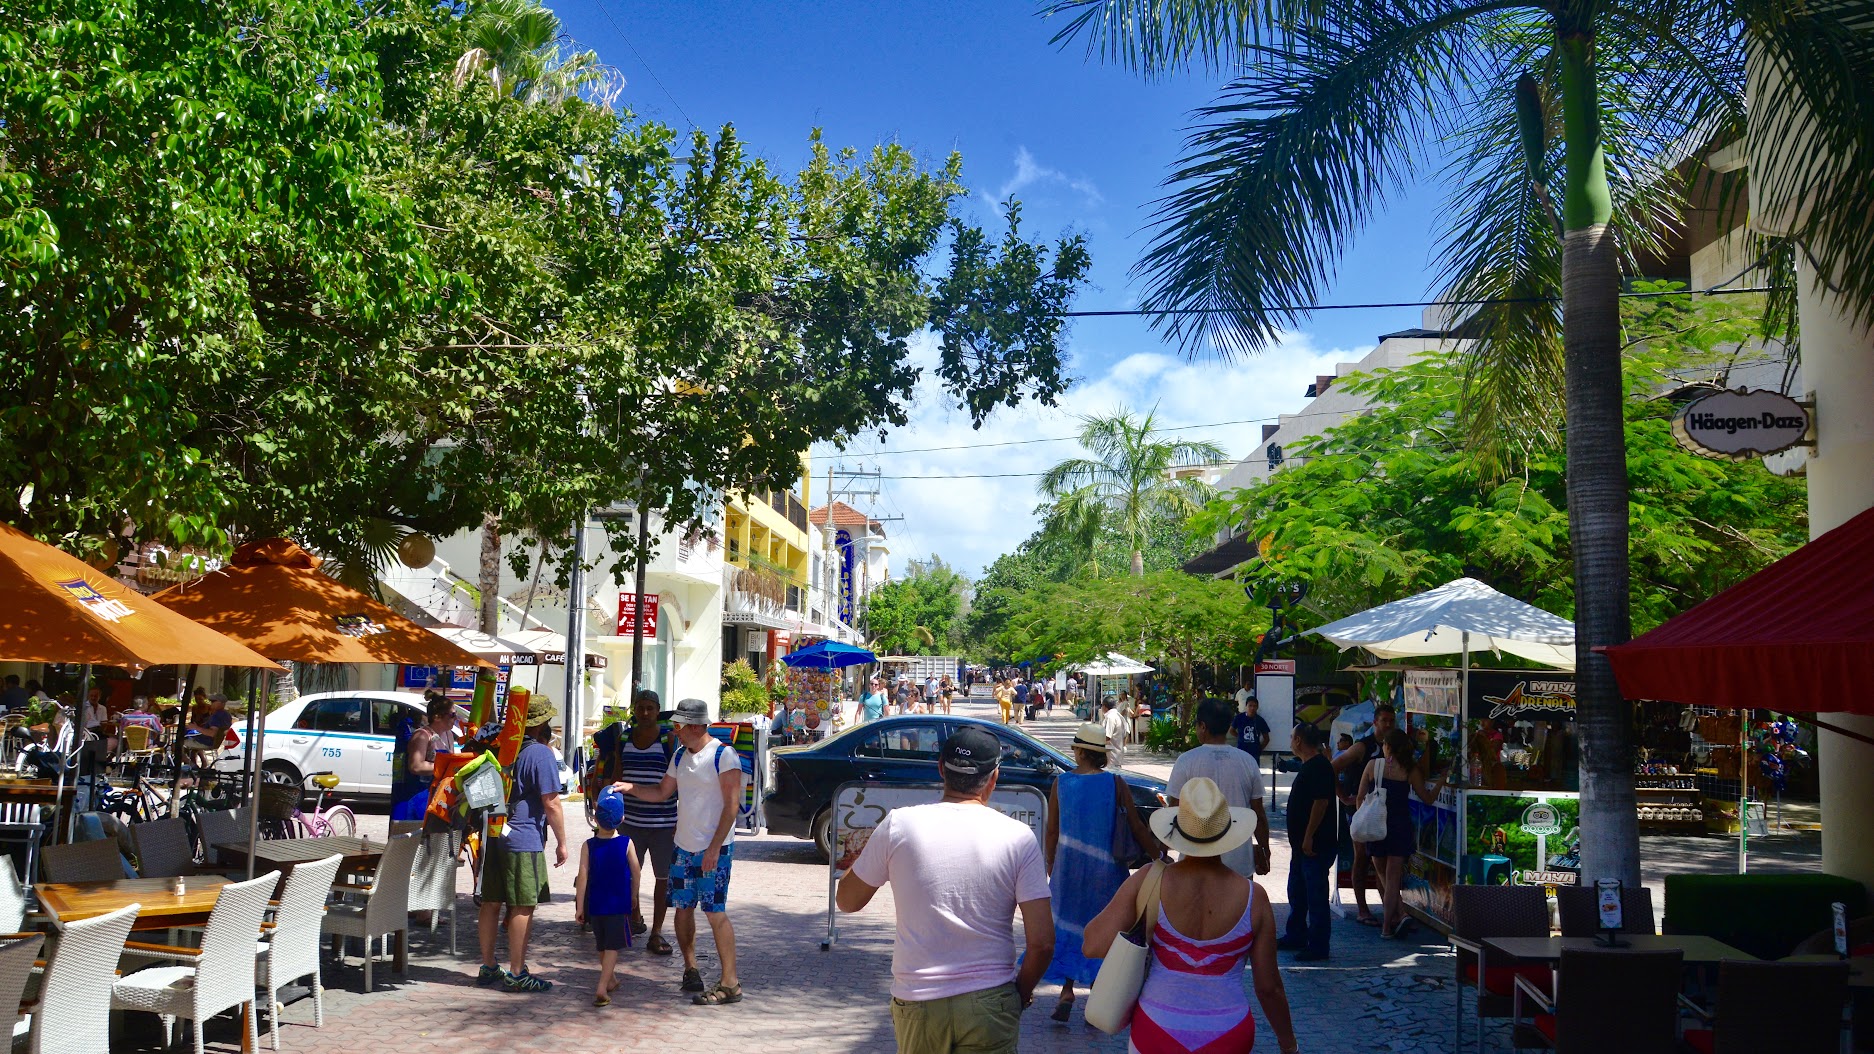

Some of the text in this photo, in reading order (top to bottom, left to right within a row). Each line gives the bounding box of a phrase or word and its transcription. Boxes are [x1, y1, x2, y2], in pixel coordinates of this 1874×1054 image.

[1690, 412, 1804, 434] Häagen-Dazs
[620, 594, 658, 604] SE RTAN
[499, 655, 533, 664] AH CACAO
[1488, 682, 1576, 714] ADRENALIN
[322, 748, 342, 758] 755
[1524, 871, 1575, 882] MAYA
